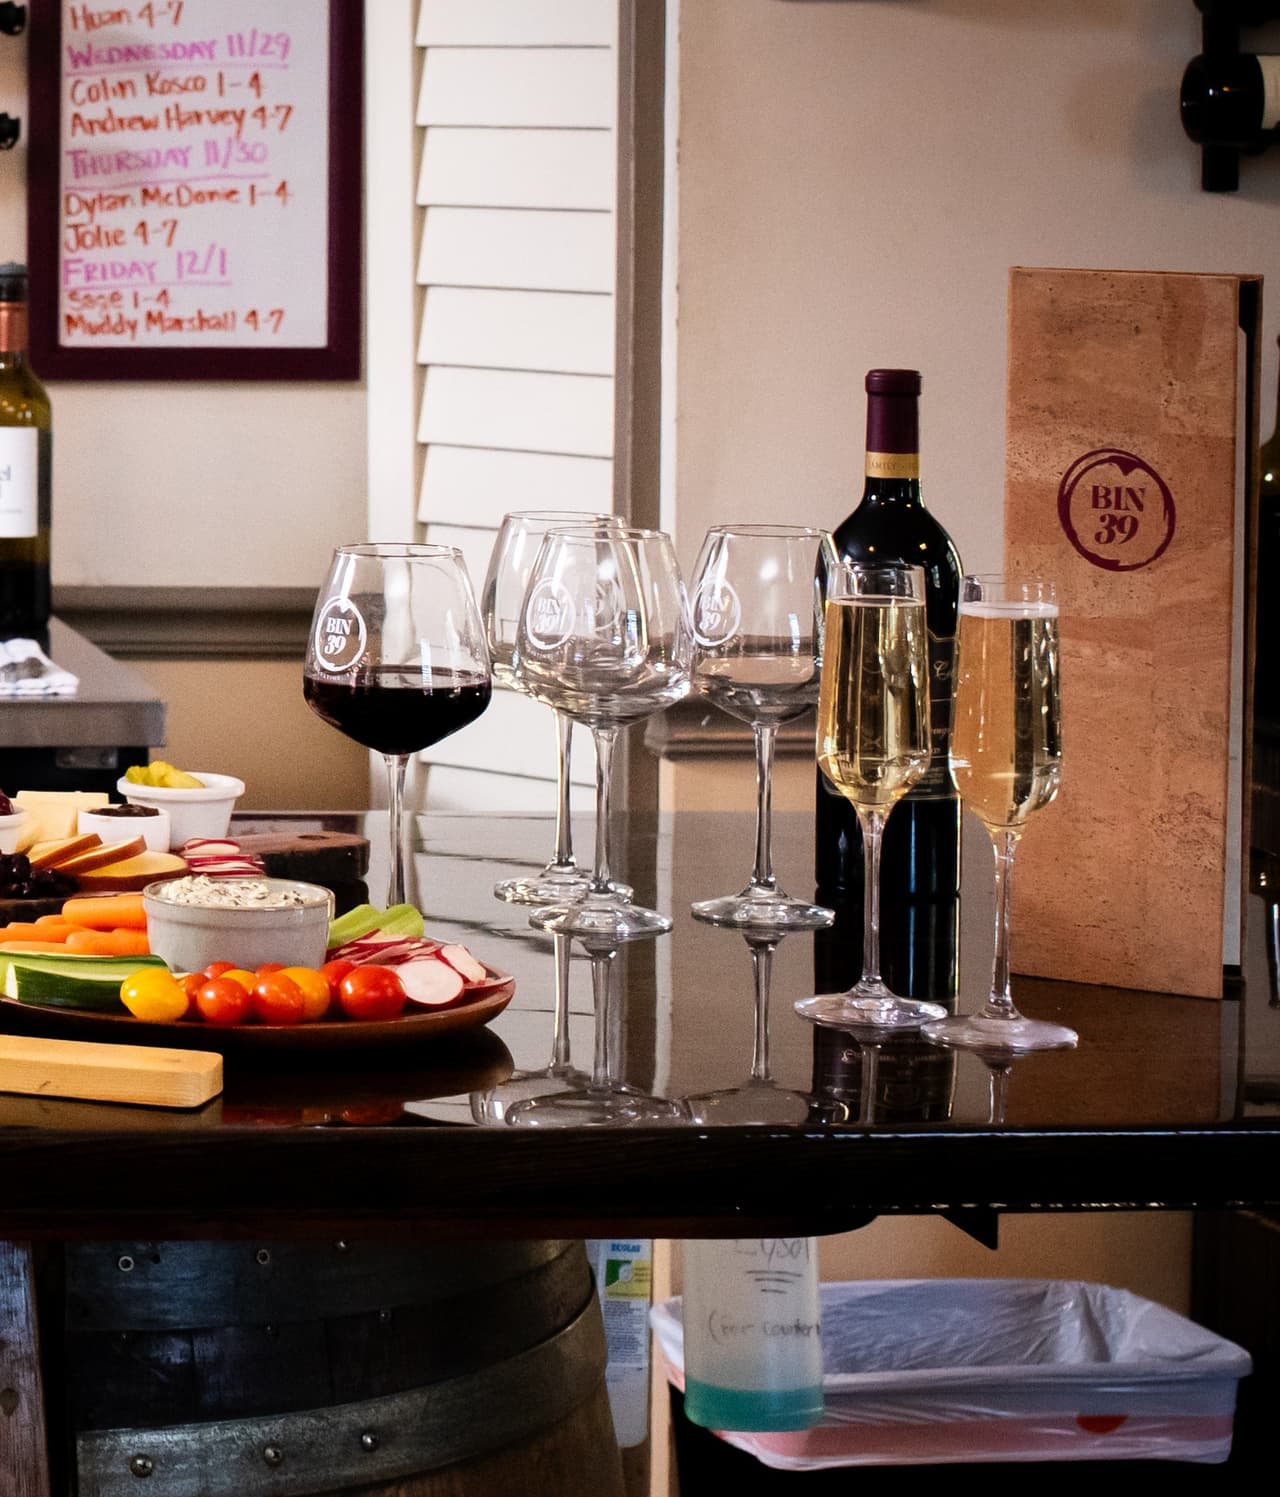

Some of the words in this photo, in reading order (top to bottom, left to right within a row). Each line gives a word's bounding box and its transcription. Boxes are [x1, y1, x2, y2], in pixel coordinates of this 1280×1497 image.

[67, 41, 216, 68] WEDNESDAY
[227, 28, 290, 60] 11/29
[71, 106, 158, 136] Andrew
[165, 103, 244, 140] Harvey
[64, 145, 192, 179] THURSDAY
[204, 137, 268, 169] 11/30
[65, 222, 127, 252] Jolie
[64, 258, 157, 286] FRIDAY
[176, 243, 227, 280] 12/1
[65, 313, 138, 341] Muddy
[146, 309, 236, 333] Marshall
[1091, 485, 1146, 512] BIN
[1094, 513, 1139, 545] 39
[326, 617, 354, 636] BIN
[324, 635, 347, 656] 39
